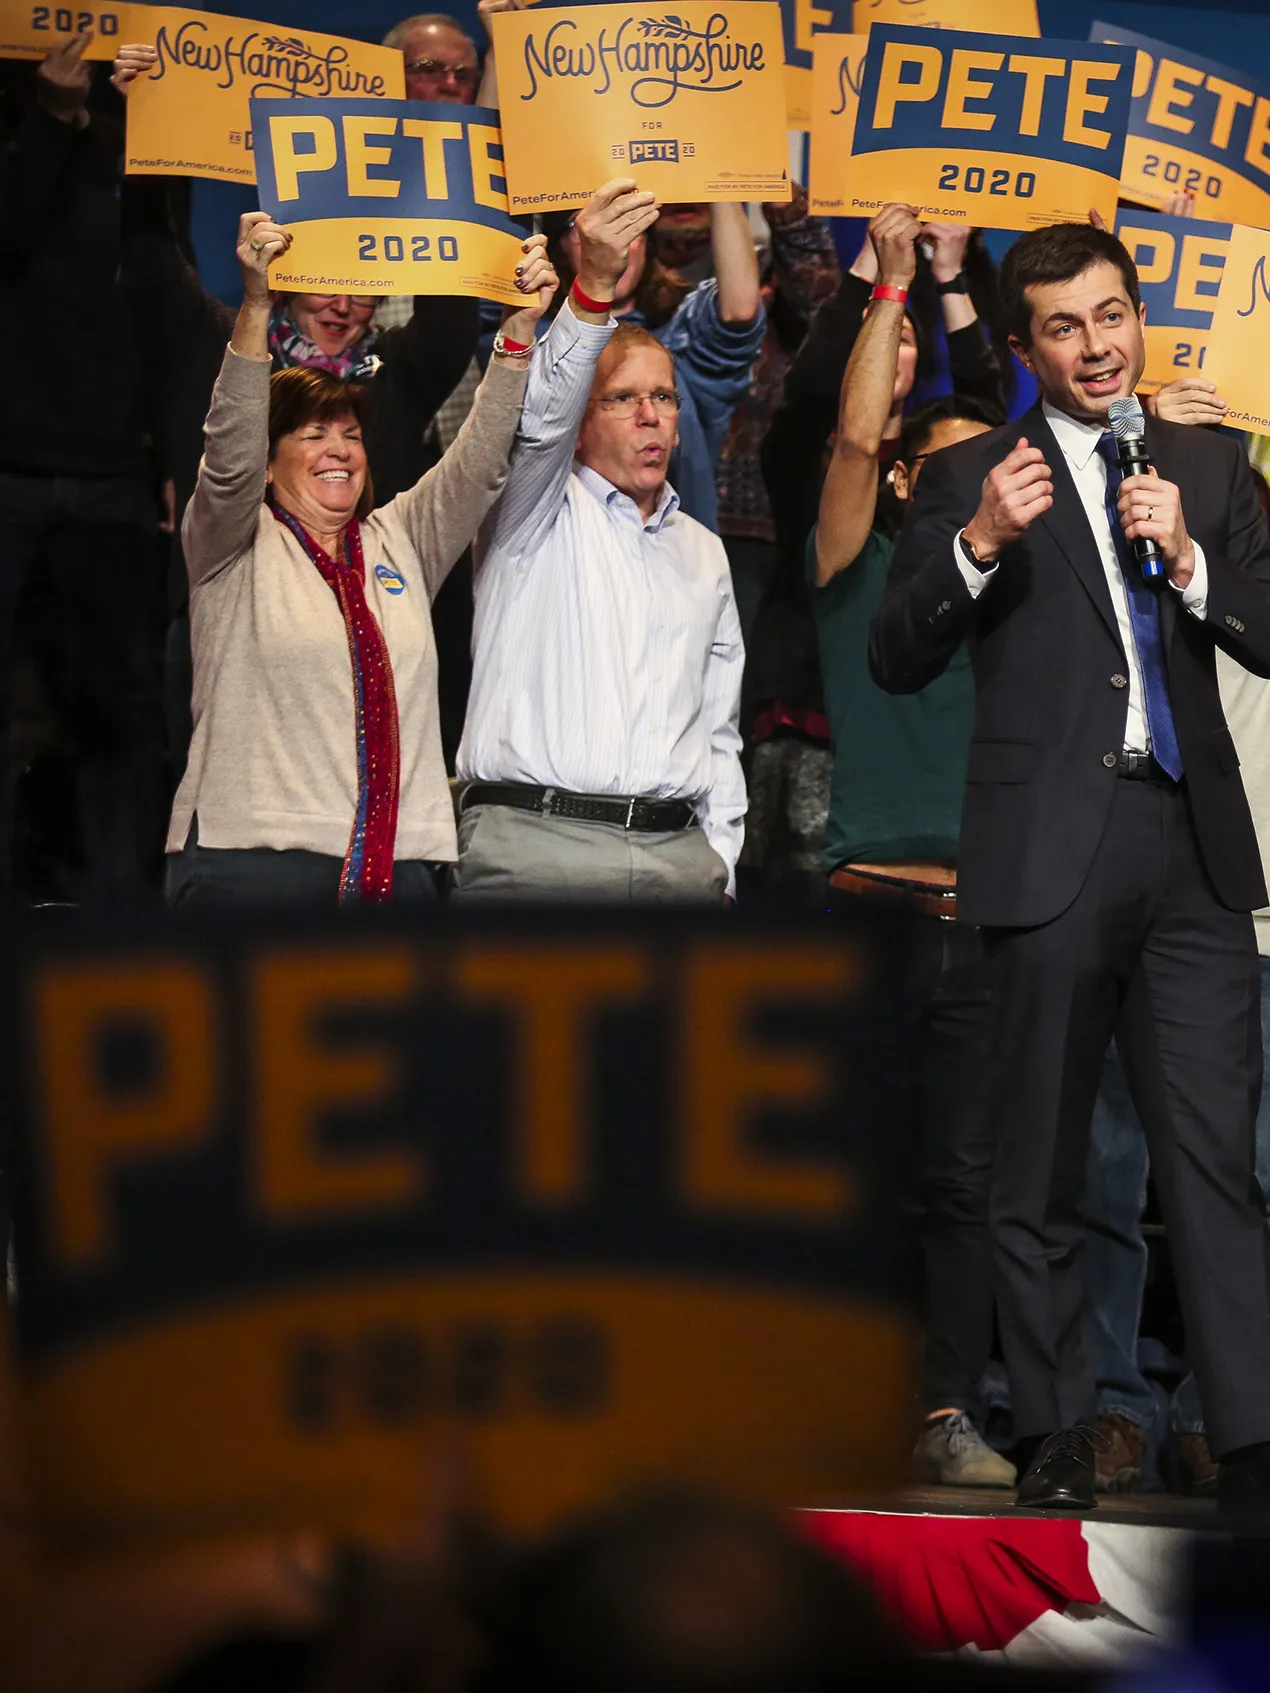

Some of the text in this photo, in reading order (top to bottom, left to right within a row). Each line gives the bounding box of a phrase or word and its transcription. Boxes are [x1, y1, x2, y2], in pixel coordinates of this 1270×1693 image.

[32, 7, 118, 35] 2020
[521, 20, 595, 100] New
[594, 13, 765, 107] Hampshire
[872, 42, 1121, 150] PETE
[642, 121, 663, 130] FOR
[269, 115, 510, 202] PETE
[632, 142, 676, 161] PETE
[938, 164, 1036, 198] 2020
[1143, 154, 1222, 199] 2020
[512, 188, 597, 205] PeteForAmer
[852, 198, 967, 217] PeteFerica.com
[358, 234, 459, 262] 2020
[275, 272, 395, 288] PeteForAmerica.com
[1118, 226, 1230, 312] PE
[34, 942, 860, 1266] PETE
